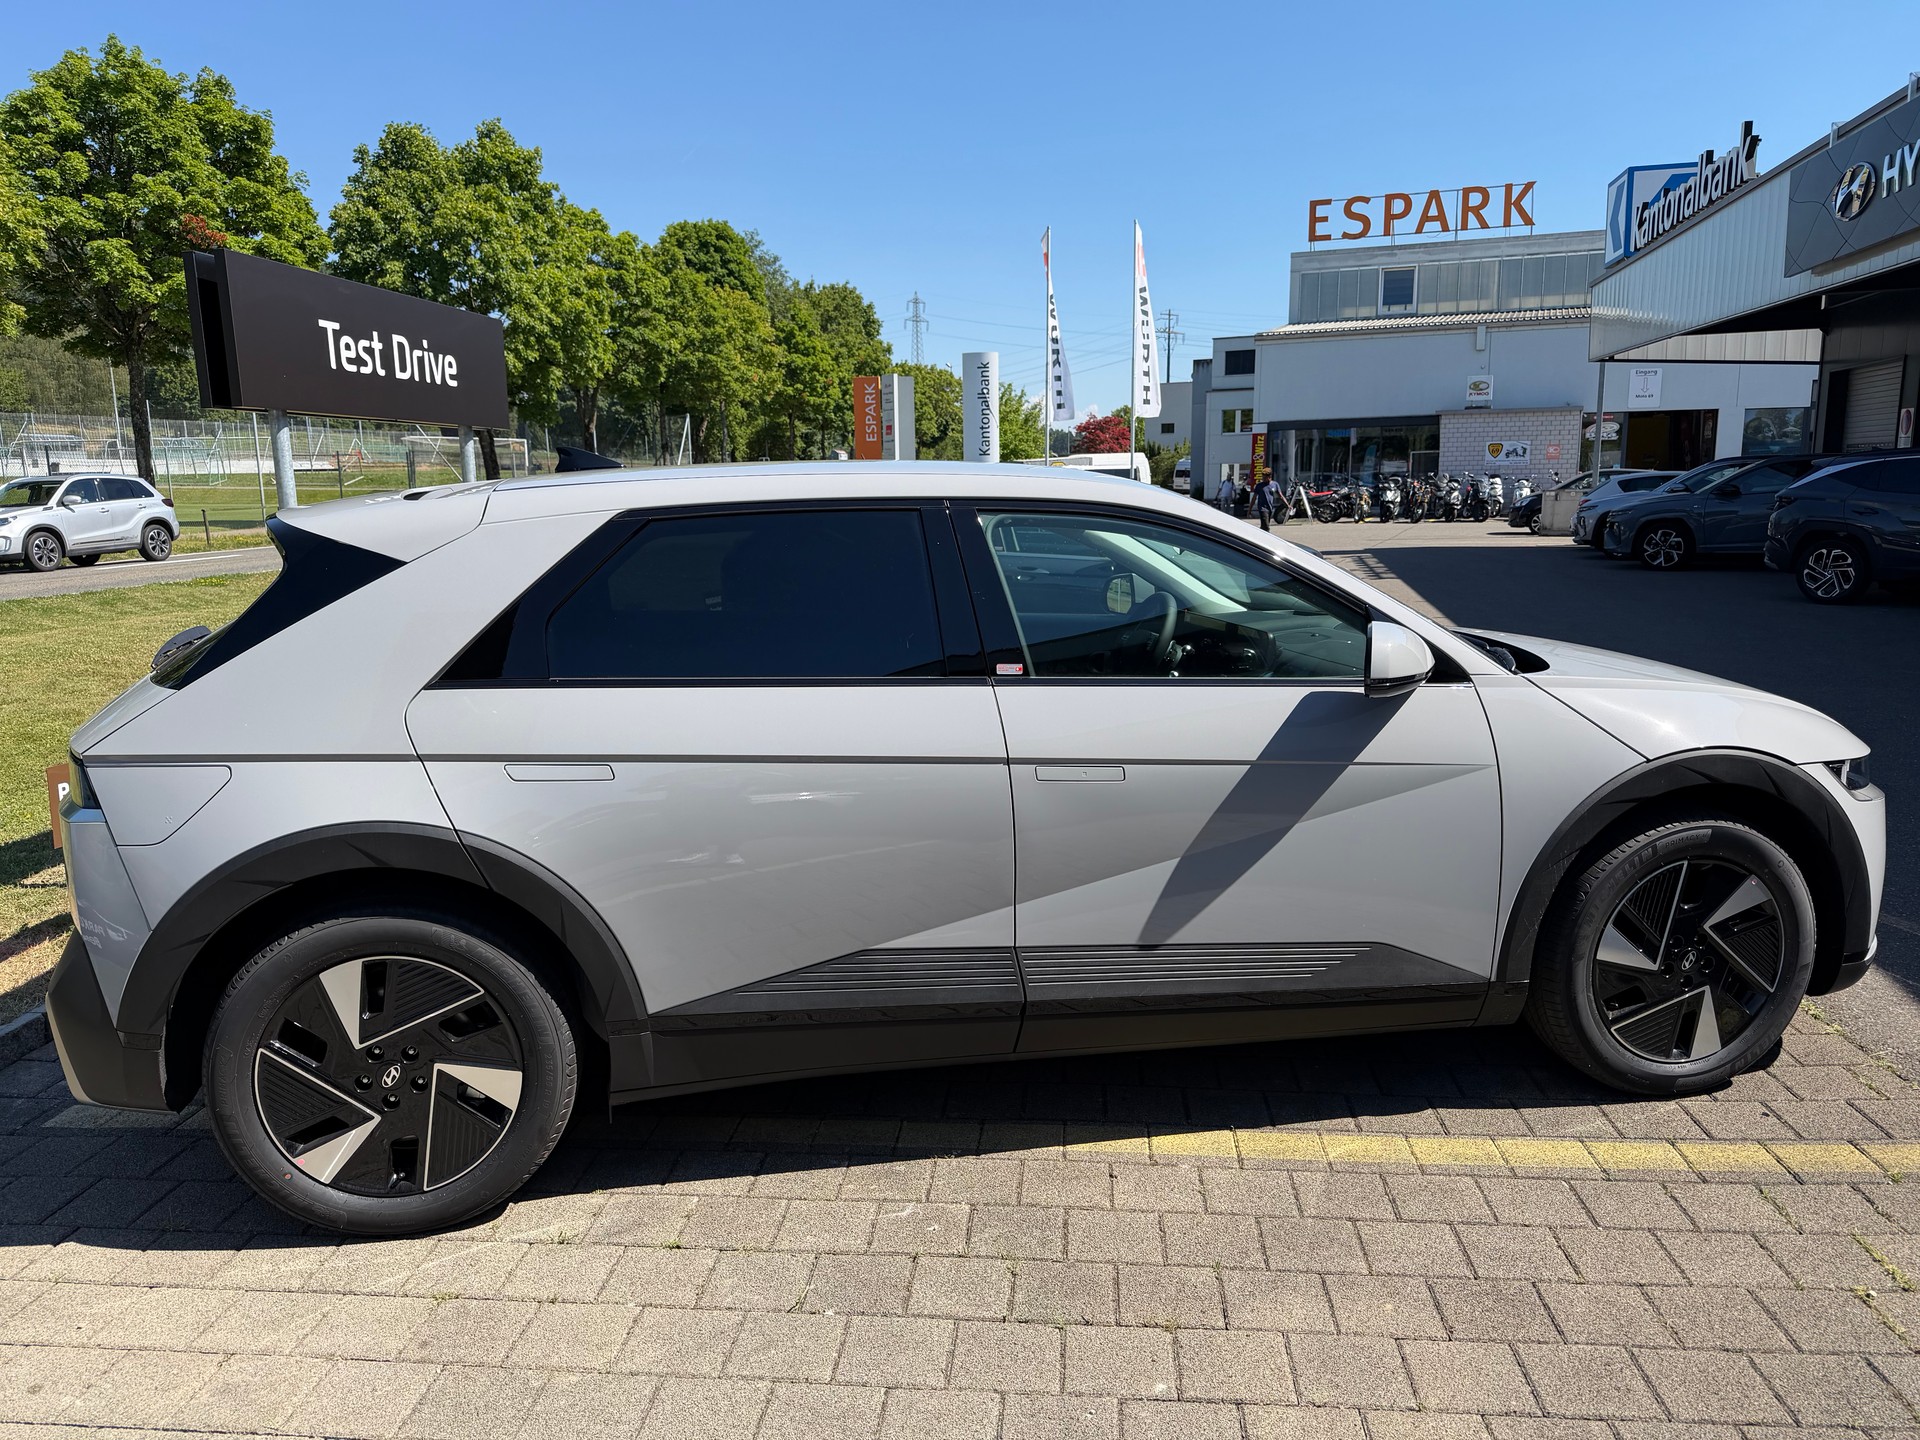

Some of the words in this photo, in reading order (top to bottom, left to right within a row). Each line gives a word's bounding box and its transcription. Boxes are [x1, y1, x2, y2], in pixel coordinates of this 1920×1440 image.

[1631, 121, 1760, 252] Kantonalbank
[1882, 138, 1920, 199] HY
[1308, 181, 1537, 242] ESPARK
[318, 319, 386, 377] Test
[392, 334, 458, 387] Drive
[1635, 369, 1658, 377] Eingang
[864, 383, 877, 441] ESPARK
[977, 361, 991, 456] Kantonalbank
[1253, 435, 1264, 487] chibli&Wirz
